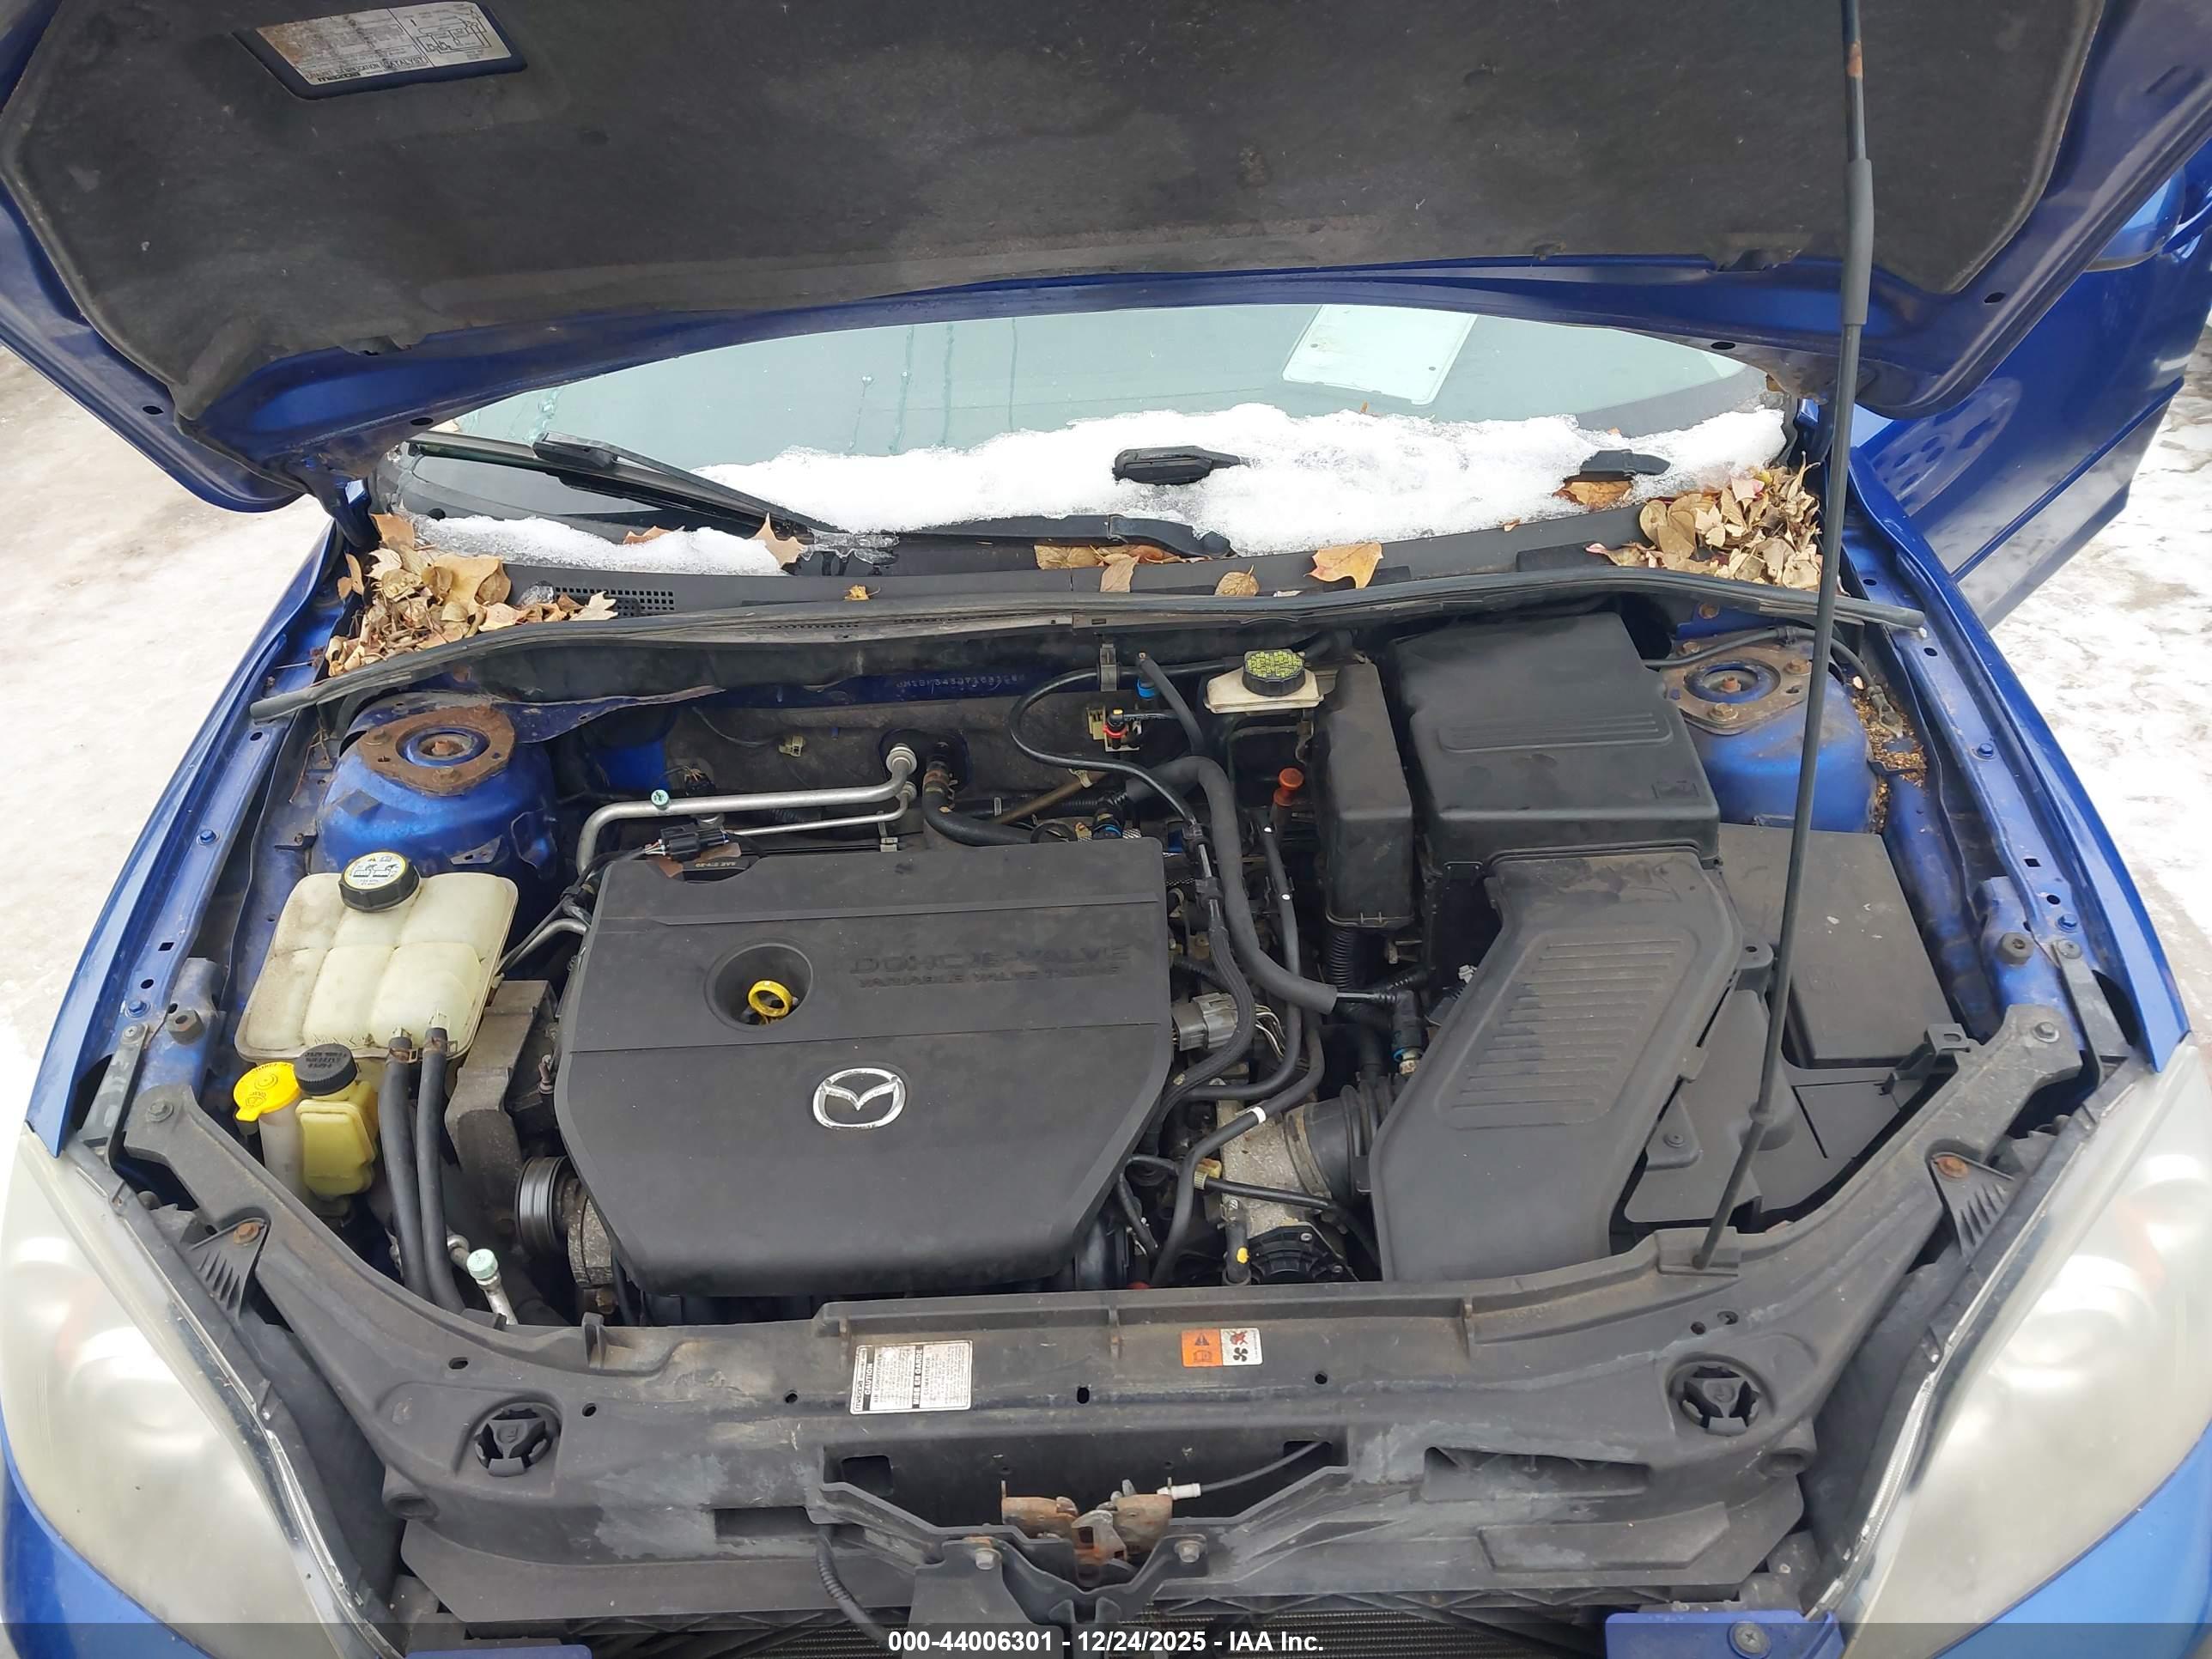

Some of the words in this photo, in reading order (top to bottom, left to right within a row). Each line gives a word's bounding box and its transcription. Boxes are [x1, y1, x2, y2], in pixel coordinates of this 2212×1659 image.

[384, 56, 425, 70] CATALYST
[915, 1348, 923, 1374] GARDE
[864, 1363, 873, 1395] CAUTION
[914, 1375, 921, 1386] EN
